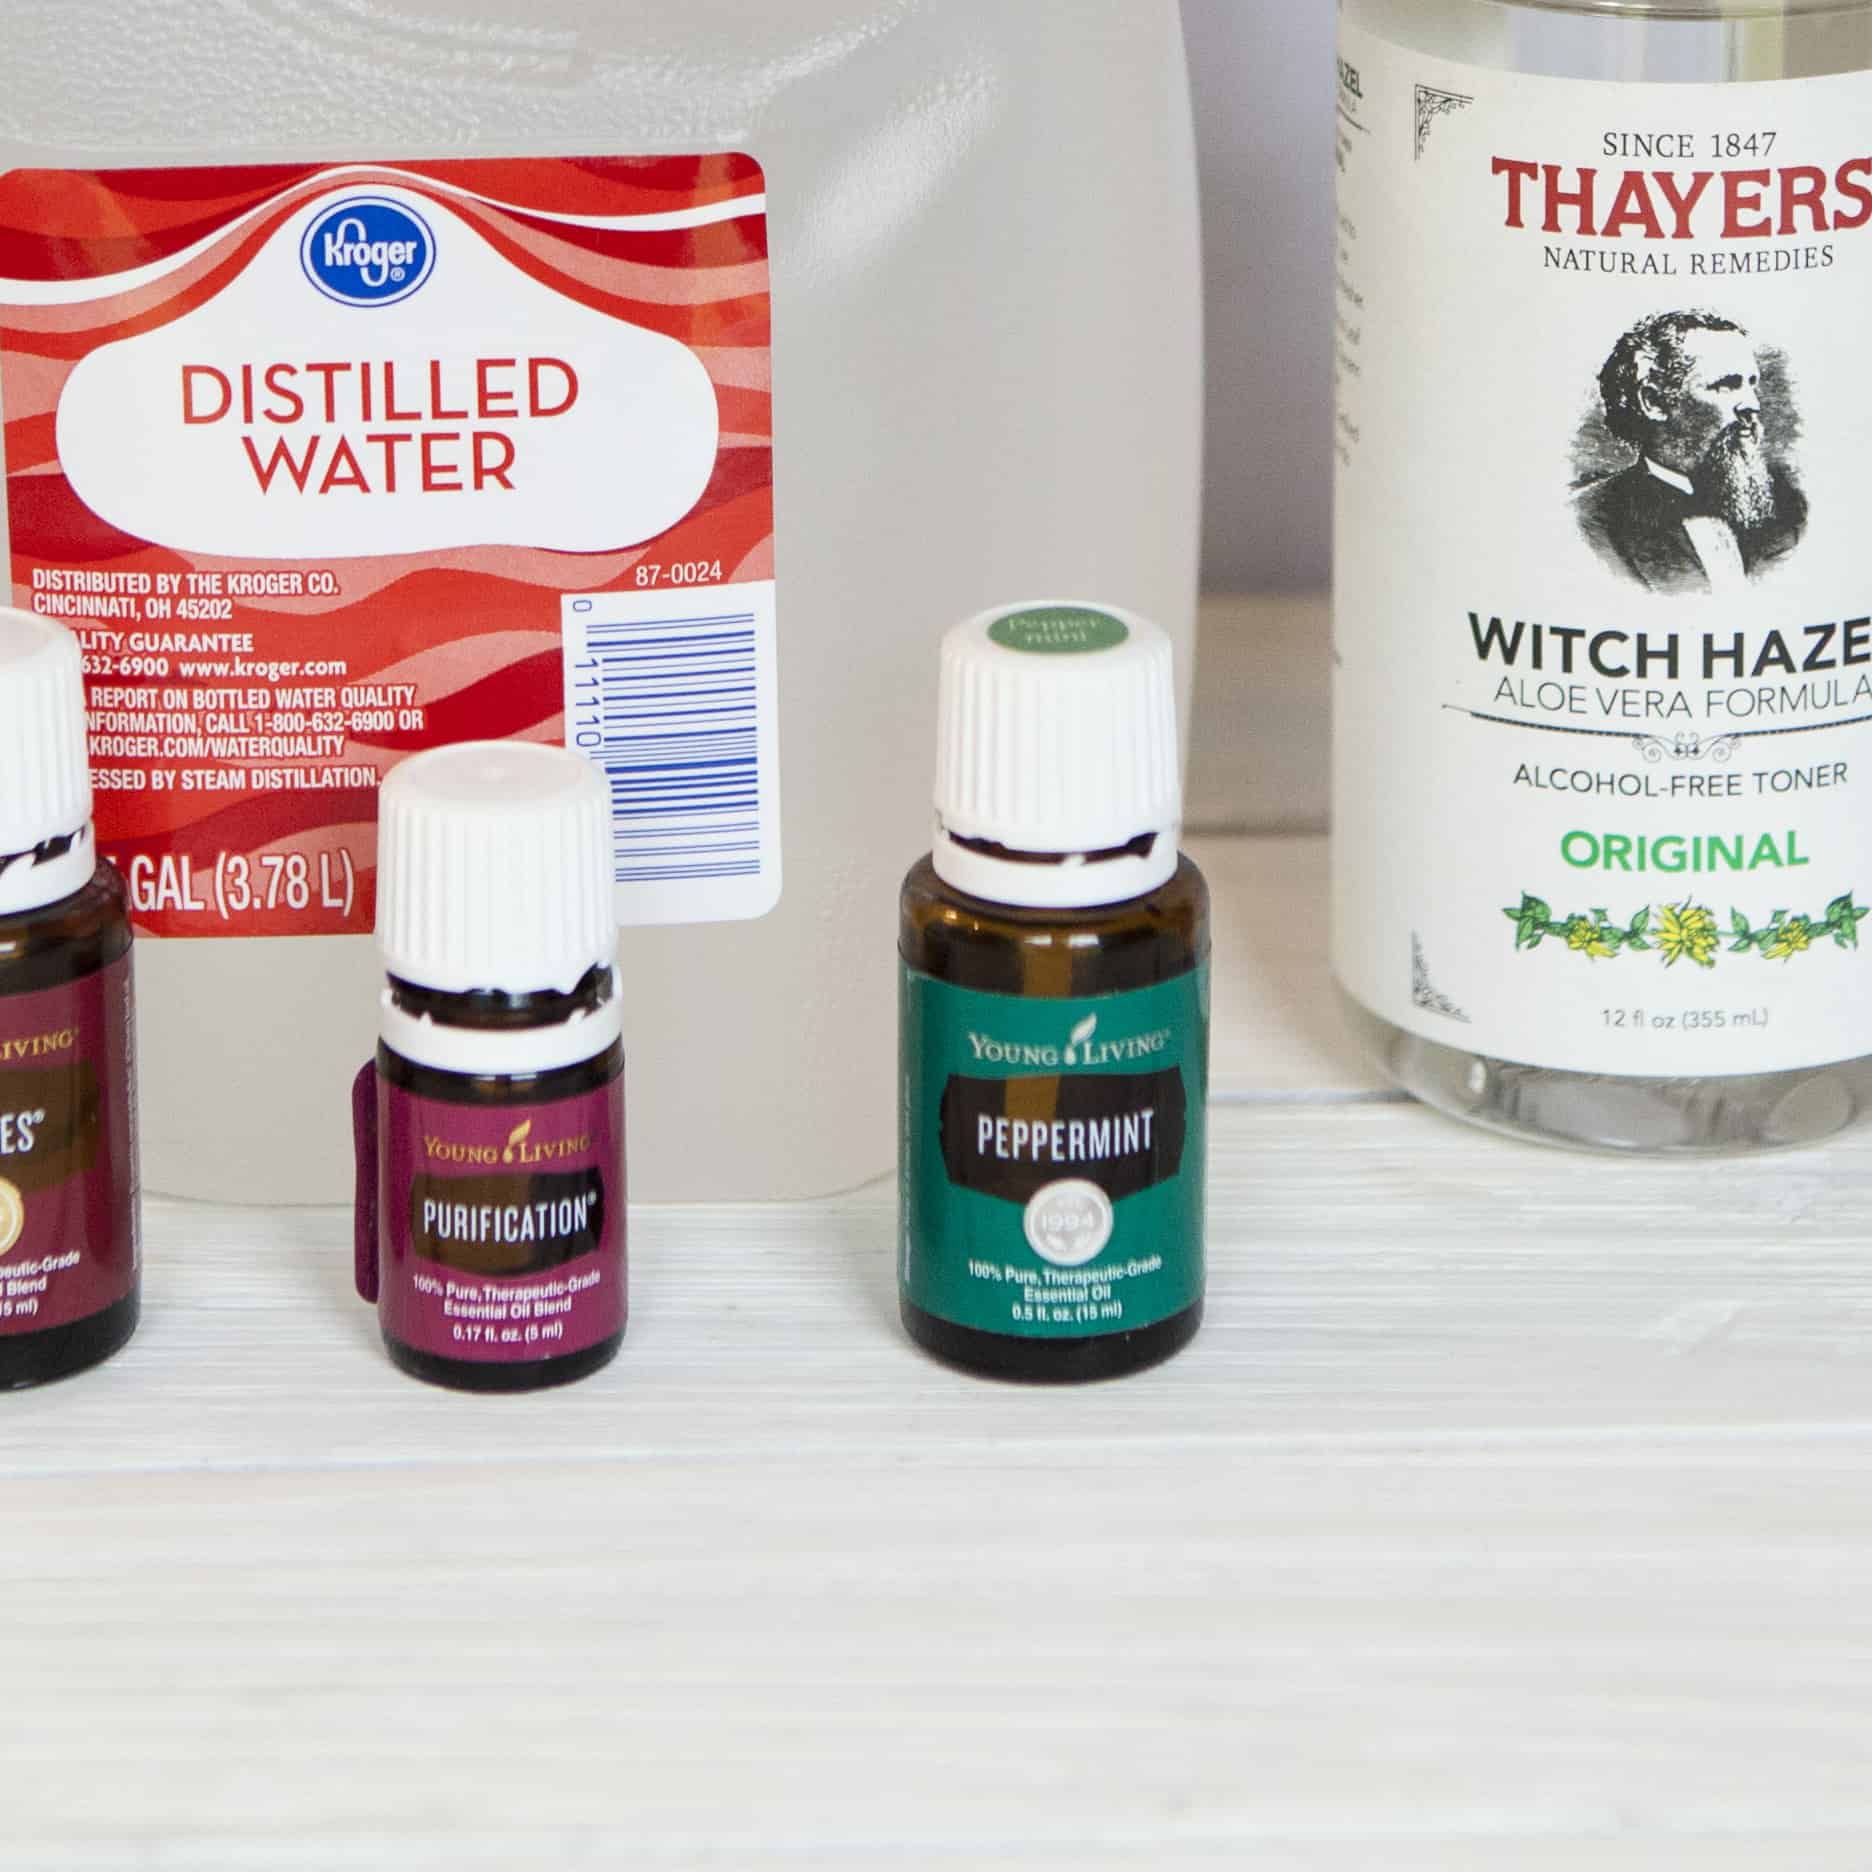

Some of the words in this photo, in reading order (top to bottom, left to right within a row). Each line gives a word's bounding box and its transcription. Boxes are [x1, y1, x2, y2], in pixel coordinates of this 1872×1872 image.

[1602, 132, 1695, 159] SINCE
[1710, 130, 1778, 160] 1847
[324, 217, 418, 288] Kroger
[1543, 245, 1677, 276] NATURAL
[1689, 243, 1835, 276] REMEDIES
[181, 355, 581, 426] DISTILLED
[240, 428, 518, 496] WATER
[32, 568, 151, 594] DISTRIBUTED
[156, 572, 182, 595] BY
[186, 573, 223, 595] THE
[227, 572, 303, 596] KROGER
[308, 572, 339, 595] CO.
[635, 560, 723, 587] 87-0024
[33, 595, 142, 621] CINCINNATI,
[146, 598, 172, 619] OH
[176, 598, 233, 619] 45202
[129, 632, 254, 653] GUARANTEE
[1467, 611, 1679, 679] WITCH
[179, 658, 348, 681] www.kroger.com
[91, 687, 157, 709] REPORT
[162, 688, 188, 710] ON
[193, 688, 270, 710] BOTTLED
[275, 687, 336, 709] WATER
[341, 685, 416, 708] QUALITY
[1492, 675, 1587, 715] ALOE
[1595, 683, 1693, 720] VERA
[206, 712, 250, 734] CALL
[254, 711, 394, 734] 1-800-632-6900
[399, 710, 424, 730] OR
[151, 768, 176, 790] BY
[180, 768, 246, 790] STEAM
[251, 766, 381, 790] DISTILLATION.
[1512, 762, 1742, 798] ALCOHOL-FREE
[1751, 761, 1849, 796] TONER
[1560, 829, 1810, 873] ORIGINAL
[130, 854, 205, 912] GAL
[215, 851, 310, 920] (3.78
[320, 849, 355, 917] L)
[1602, 1009, 1626, 1027] 12
[1651, 1015, 1676, 1029] oz
[1681, 1010, 1727, 1030] (355
[1732, 1007, 1769, 1028] mL)
[977, 1109, 1155, 1163] PEPPERMINT
[968, 1258, 1001, 1282] 100%
[6, 1276, 47, 1296] Blend
[413, 1273, 444, 1297] 100%
[1024, 1284, 1088, 1303] Essential
[1091, 1283, 1111, 1301] Oil
[444, 1299, 507, 1320] Essential
[510, 1302, 530, 1320] Oil
[534, 1296, 572, 1318] Blend
[1011, 1302, 1034, 1321] 0.5
[453, 1323, 481, 1342] 0.17
